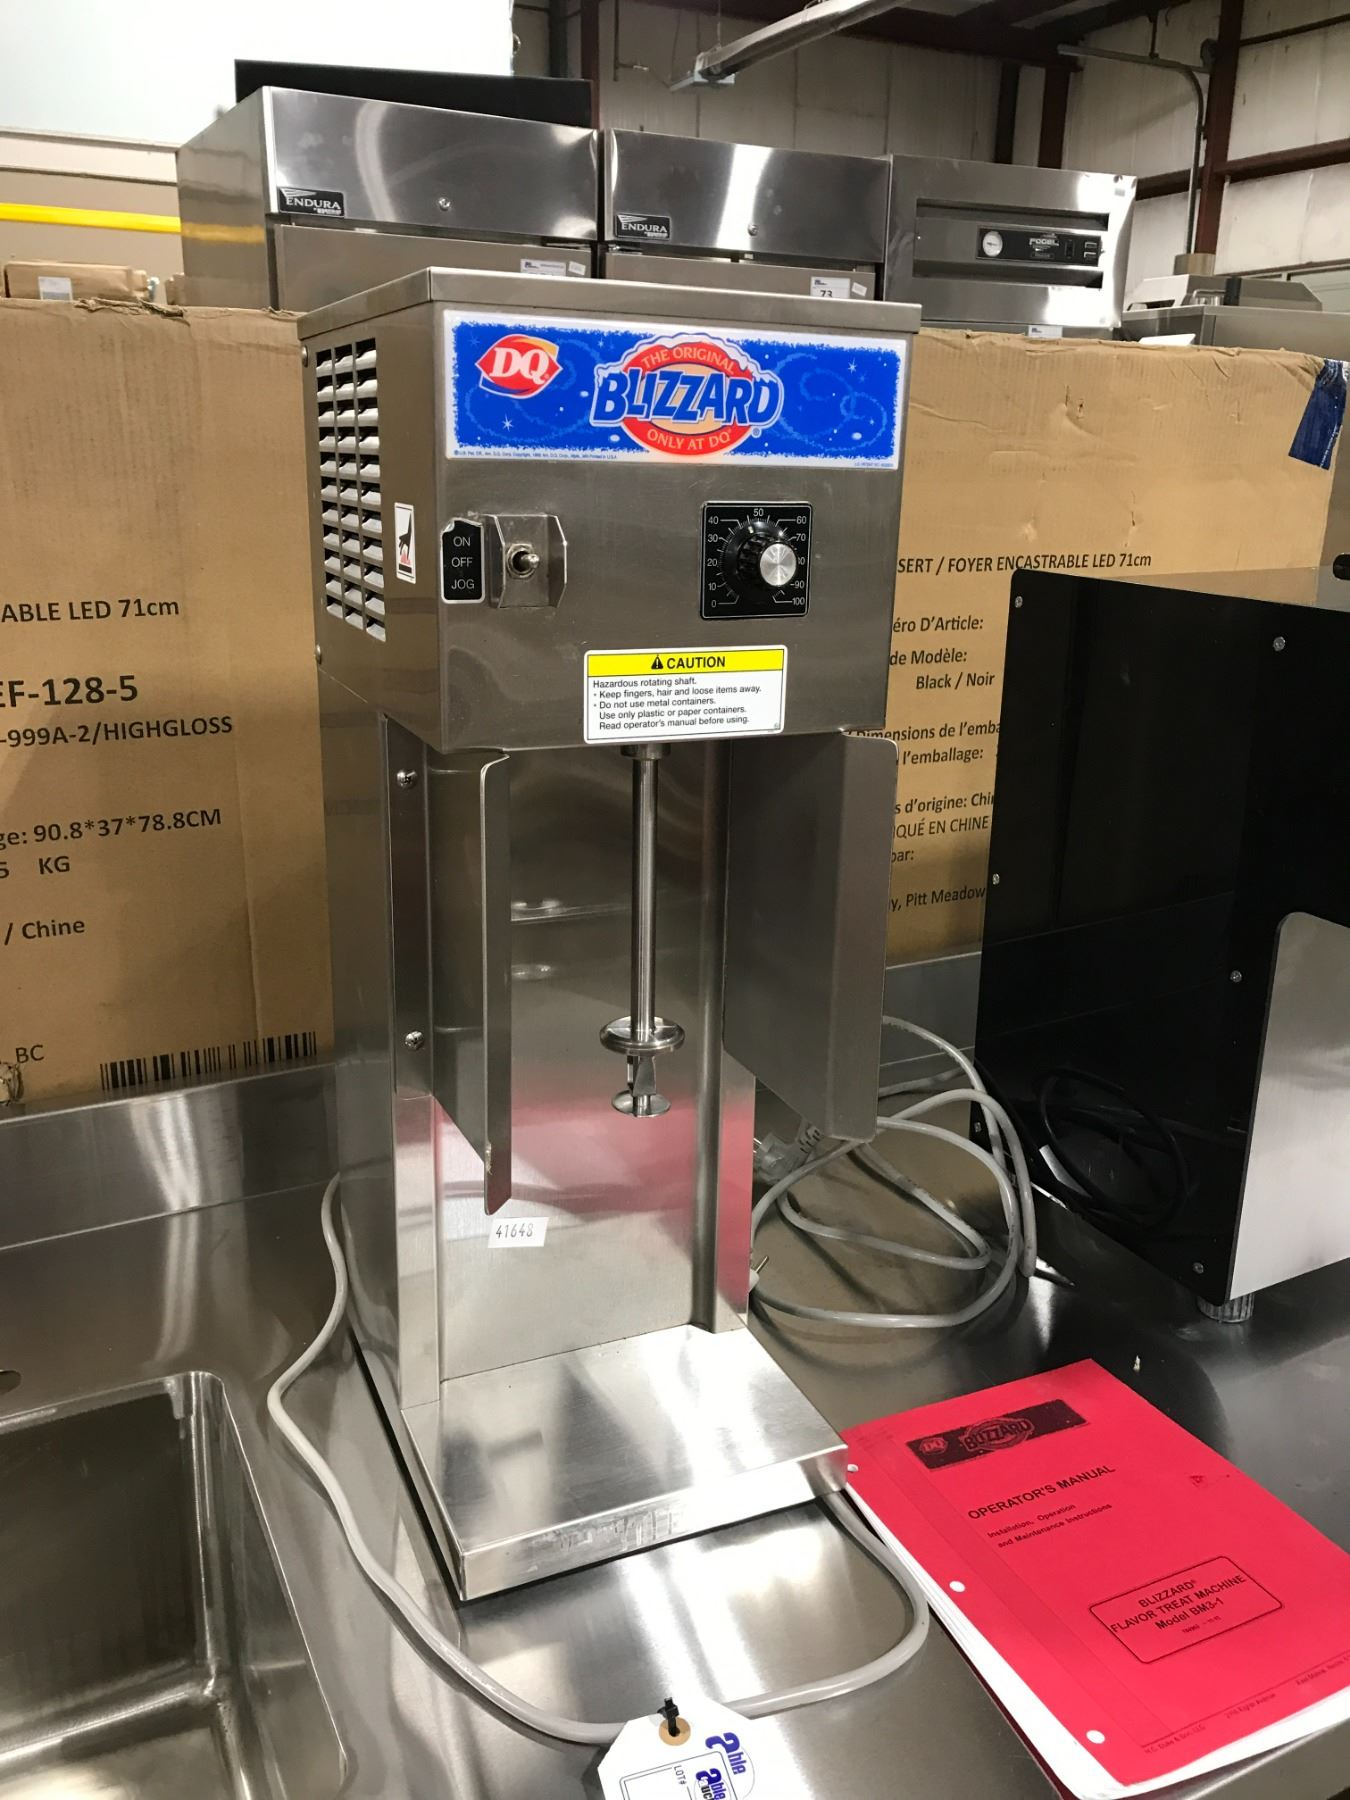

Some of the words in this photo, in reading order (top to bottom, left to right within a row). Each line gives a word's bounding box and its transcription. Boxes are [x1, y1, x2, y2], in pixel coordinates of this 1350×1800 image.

[286, 197, 342, 210] ENDURA
[621, 222, 668, 233] ENDURA
[641, 350, 662, 370] THE
[672, 345, 736, 376] ORIGINAL
[592, 367, 778, 425] BLIZZARD
[647, 429, 686, 451] ONLY
[687, 436, 707, 451] AT
[708, 516, 719, 525] 40
[796, 516, 807, 525] 60
[753, 508, 764, 517] 50
[453, 536, 471, 547] ON
[707, 534, 719, 543] 30
[796, 533, 807, 542] 70
[451, 557, 473, 568] OFF
[707, 558, 718, 567] 20
[897, 558, 933, 574] SERT
[936, 556, 945, 576] /
[948, 557, 992, 573] FOYER
[997, 554, 1089, 571] ENCASTRABLE
[1092, 553, 1115, 568] LED
[1119, 553, 1152, 568] 71cm
[451, 579, 475, 590] JOG
[708, 583, 717, 591] 10
[794, 581, 805, 589] 90
[1, 602, 61, 623] ABLE
[69, 600, 111, 621] LED
[118, 599, 179, 618] 71cm
[711, 600, 717, 608] 0
[792, 597, 805, 606] 100
[666, 656, 726, 670] CAUTION
[911, 648, 968, 665] Modèle:
[593, 679, 639, 689] Hazardous
[640, 678, 673, 688] rotating
[674, 677, 697, 686] shaft.
[916, 673, 952, 690] Black
[955, 672, 964, 690] /
[966, 672, 996, 687] Noir
[599, 690, 622, 700] Keep
[624, 688, 655, 699] fingers,
[656, 688, 673, 697] hair
[674, 687, 690, 696] and
[692, 686, 714, 695] loose
[716, 685, 738, 694] items
[739, 686, 762, 694] away.
[599, 701, 612, 709] Do
[613, 701, 628, 709] not
[629, 701, 645, 709] use
[646, 698, 670, 708] metal
[671, 696, 717, 706] containers.
[599, 711, 616, 720] Use
[617, 709, 636, 720] only
[637, 707, 665, 719] plastic
[667, 709, 676, 717] or
[677, 708, 701, 718] paper
[703, 705, 748, 715] containers.
[599, 721, 622, 731] Read
[623, 719, 666, 730] operator's
[667, 717, 697, 727] manual
[698, 716, 725, 725] before
[726, 715, 750, 725] using.
[938, 723, 956, 738] de
[929, 820, 946, 835] EN
[950, 815, 990, 833] CHINE
[38, 855, 71, 875] KG
[906, 891, 928, 908] Pitt
[931, 885, 986, 905] Meadow
[4, 922, 14, 946] /
[21, 919, 86, 940] Chine
[15, 1044, 45, 1064] BC
[495, 1222, 534, 1239] 41648
[967, 1484, 1057, 1520] OPERATOR'S
[1056, 1464, 1116, 1490] MANUAL
[987, 1520, 1034, 1539] Installation,
[1036, 1503, 1076, 1522] Operation
[998, 1538, 1014, 1549] and
[1014, 1520, 1066, 1543] Maintenance
[1066, 1503, 1113, 1524] Instructions
[1109, 1608, 1157, 1633] FLAVOR
[1155, 1595, 1194, 1615] TREAT
[1194, 1574, 1248, 1600] MACHINE
[1154, 1611, 1190, 1630] Model
[1191, 1597, 1225, 1616] BM3-1
[673, 1764, 688, 1786] LOT#
